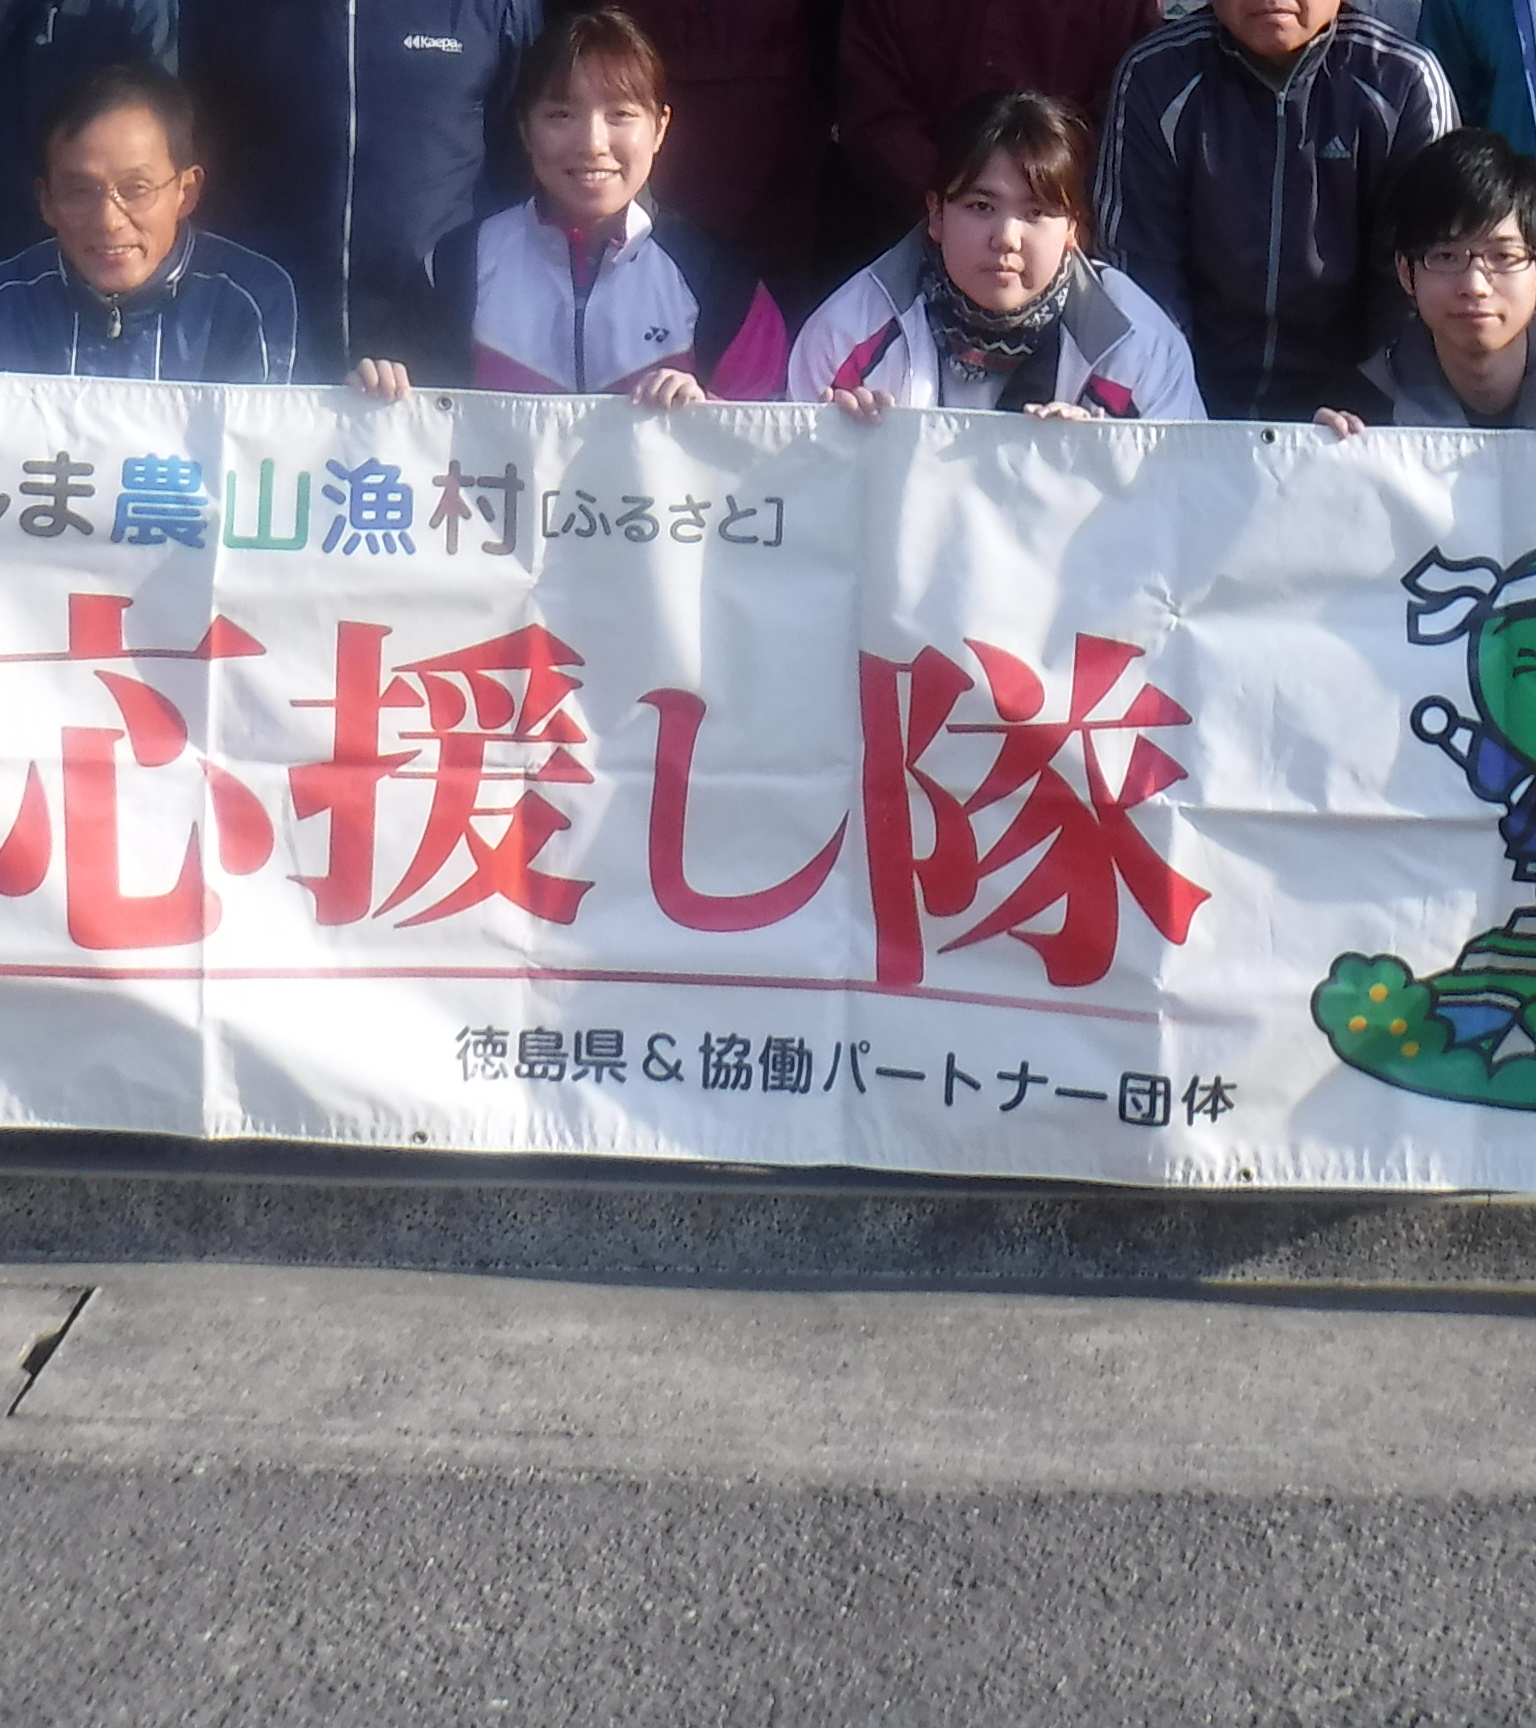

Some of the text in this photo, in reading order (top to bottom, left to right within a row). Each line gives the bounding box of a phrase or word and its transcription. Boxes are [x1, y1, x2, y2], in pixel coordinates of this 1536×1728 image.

[456, 1025, 1239, 1129] 徳島県 & 協働パートナー団体
